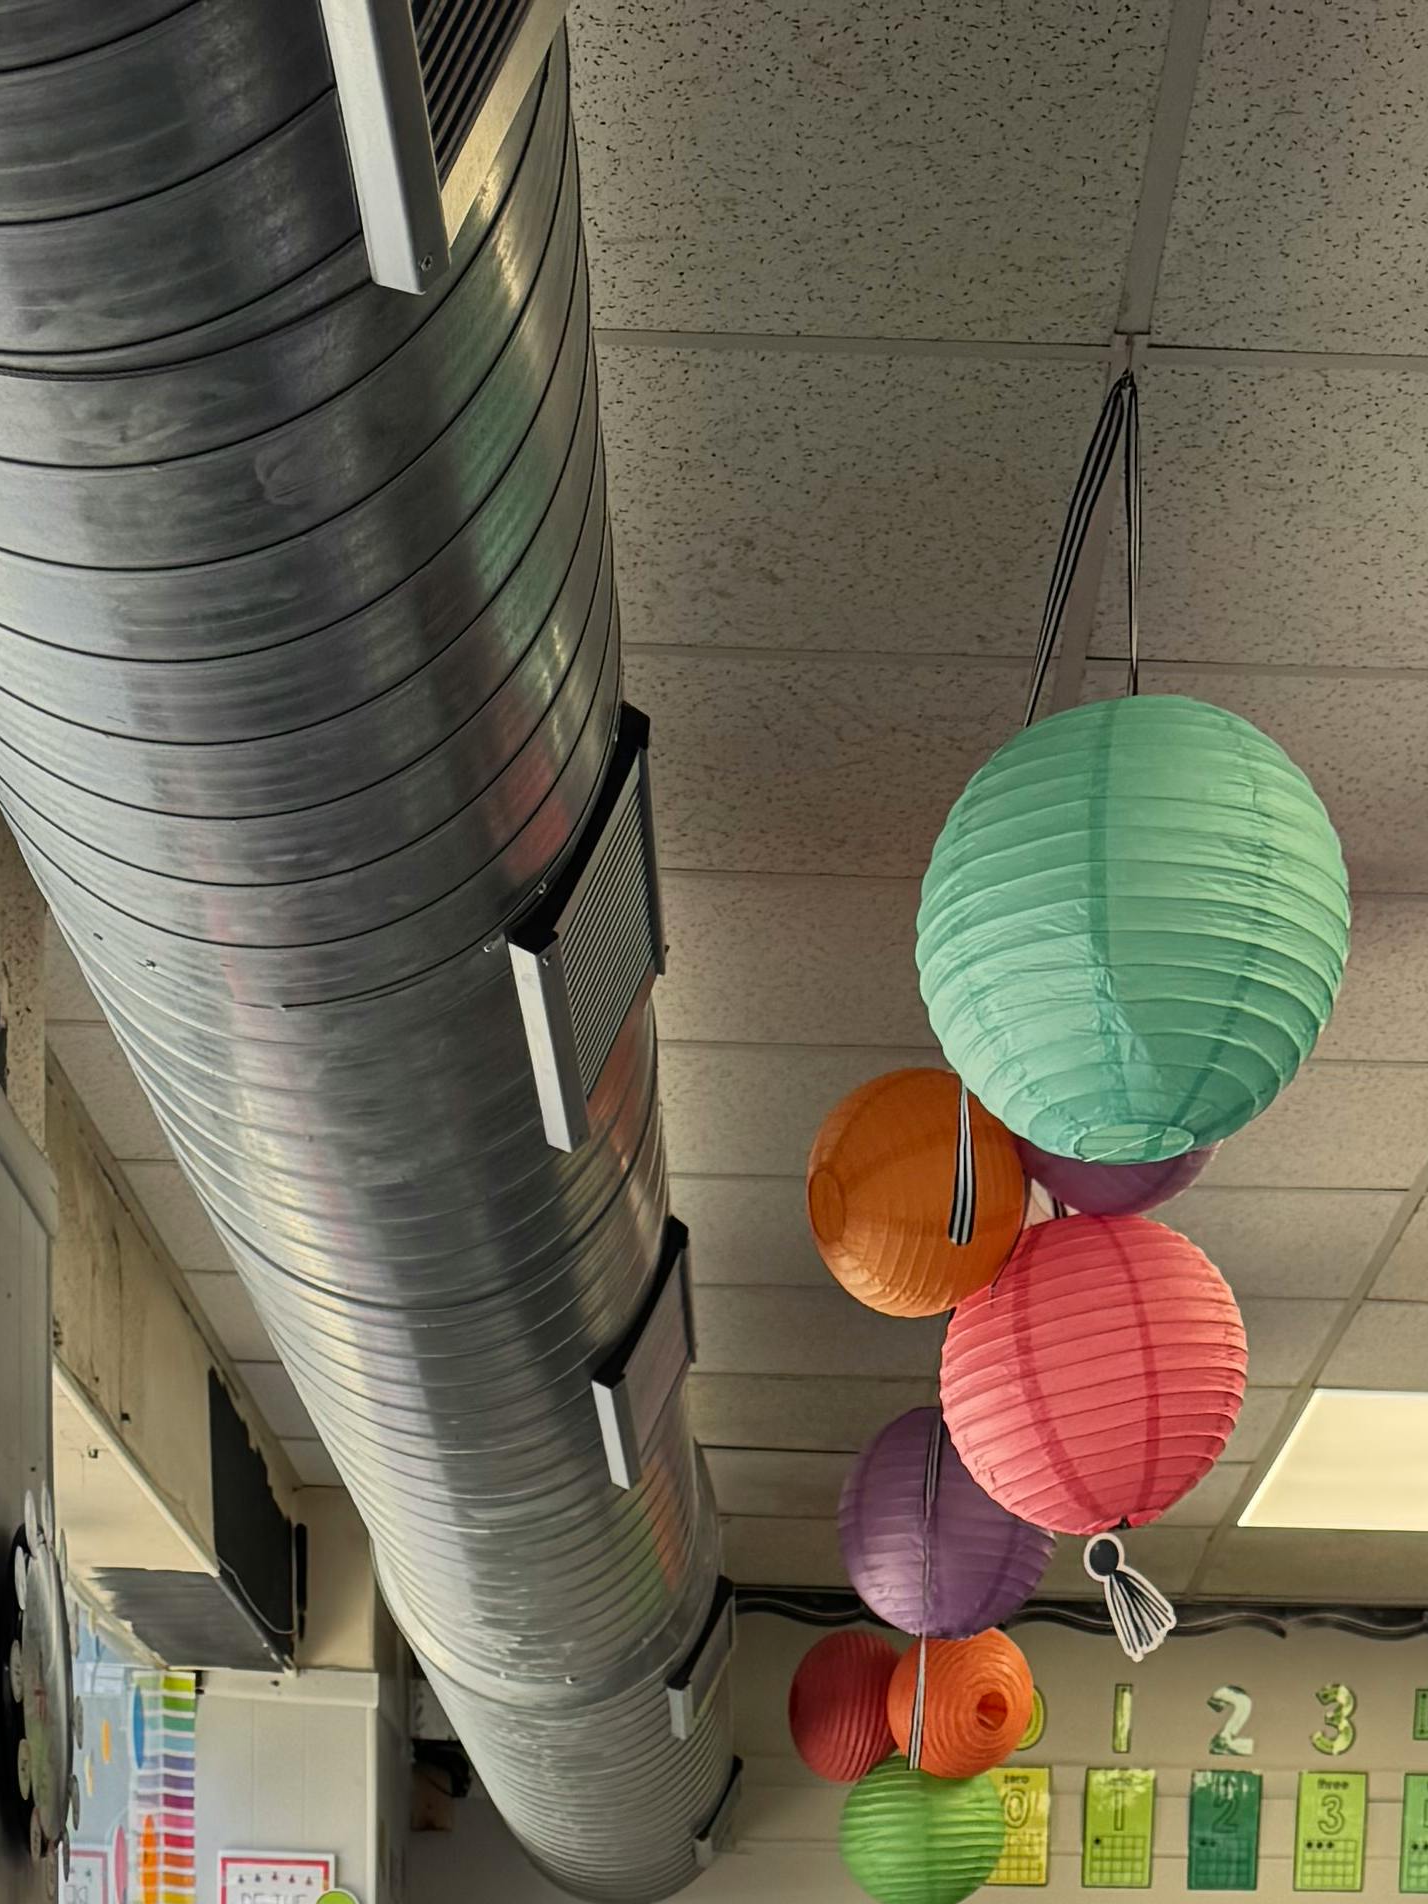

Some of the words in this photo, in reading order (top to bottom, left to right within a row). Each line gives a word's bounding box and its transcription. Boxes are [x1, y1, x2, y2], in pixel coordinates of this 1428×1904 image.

[1112, 1683, 1133, 1753] 1
[1207, 1684, 1254, 1755] 2
[1310, 1683, 1357, 1755] 3
[1317, 1779, 1351, 1791] three
[1317, 1795, 1345, 1835] 3
